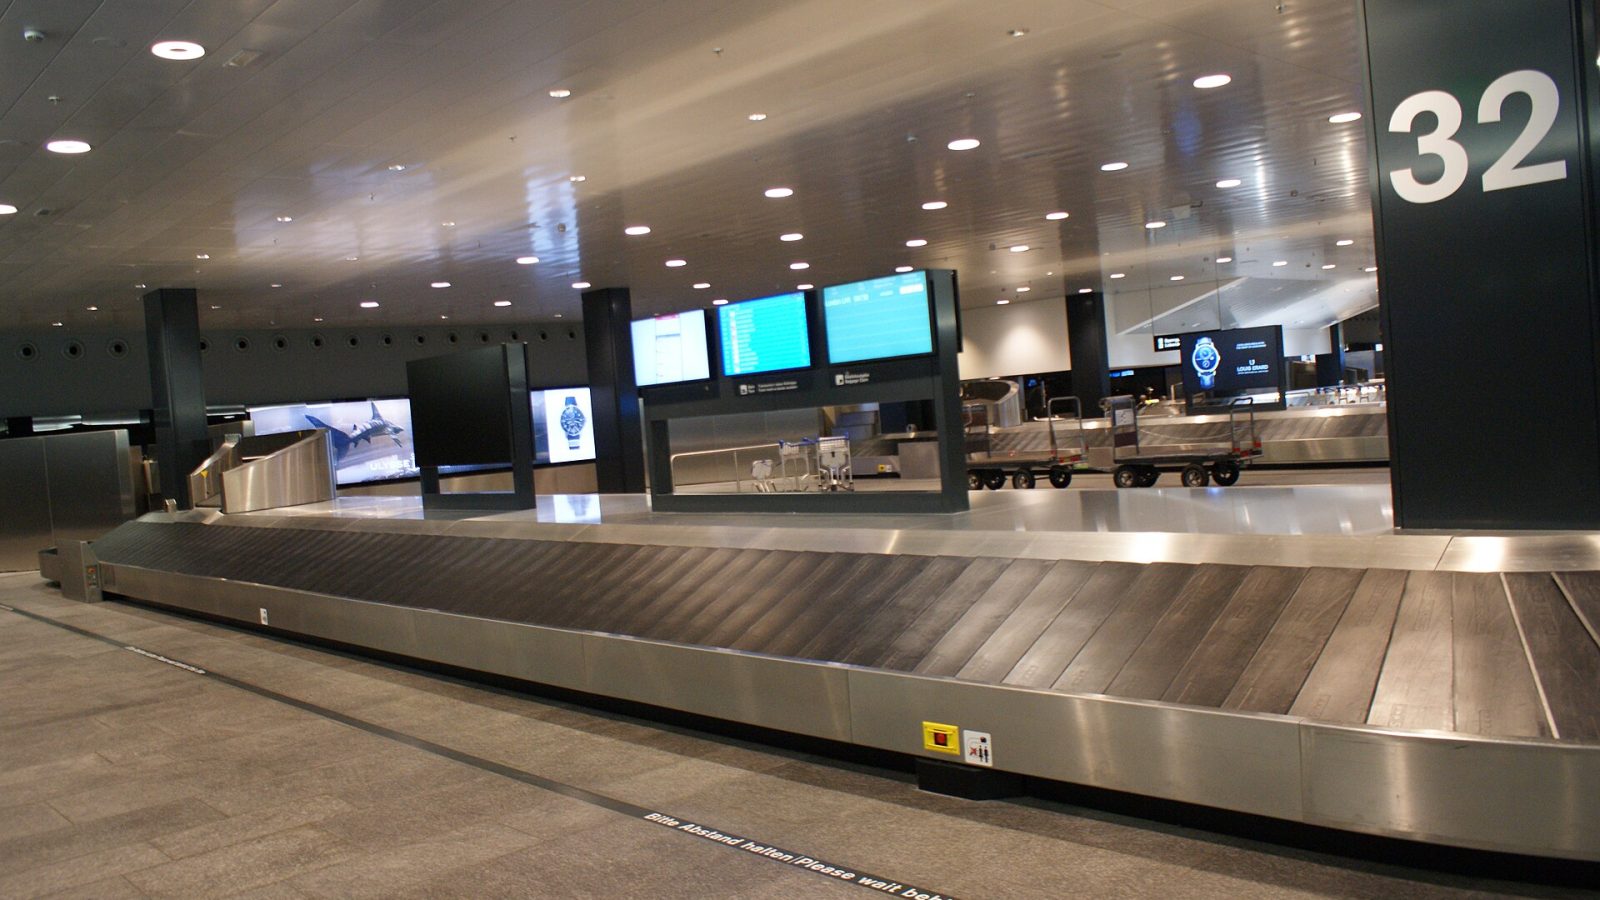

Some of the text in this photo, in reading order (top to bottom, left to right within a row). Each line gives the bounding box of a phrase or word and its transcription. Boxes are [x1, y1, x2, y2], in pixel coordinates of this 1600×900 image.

[1388, 69, 1567, 204] 32
[643, 812, 680, 827] Bitte
[679, 823, 745, 846] Abstand
[857, 876, 902, 893] wait
